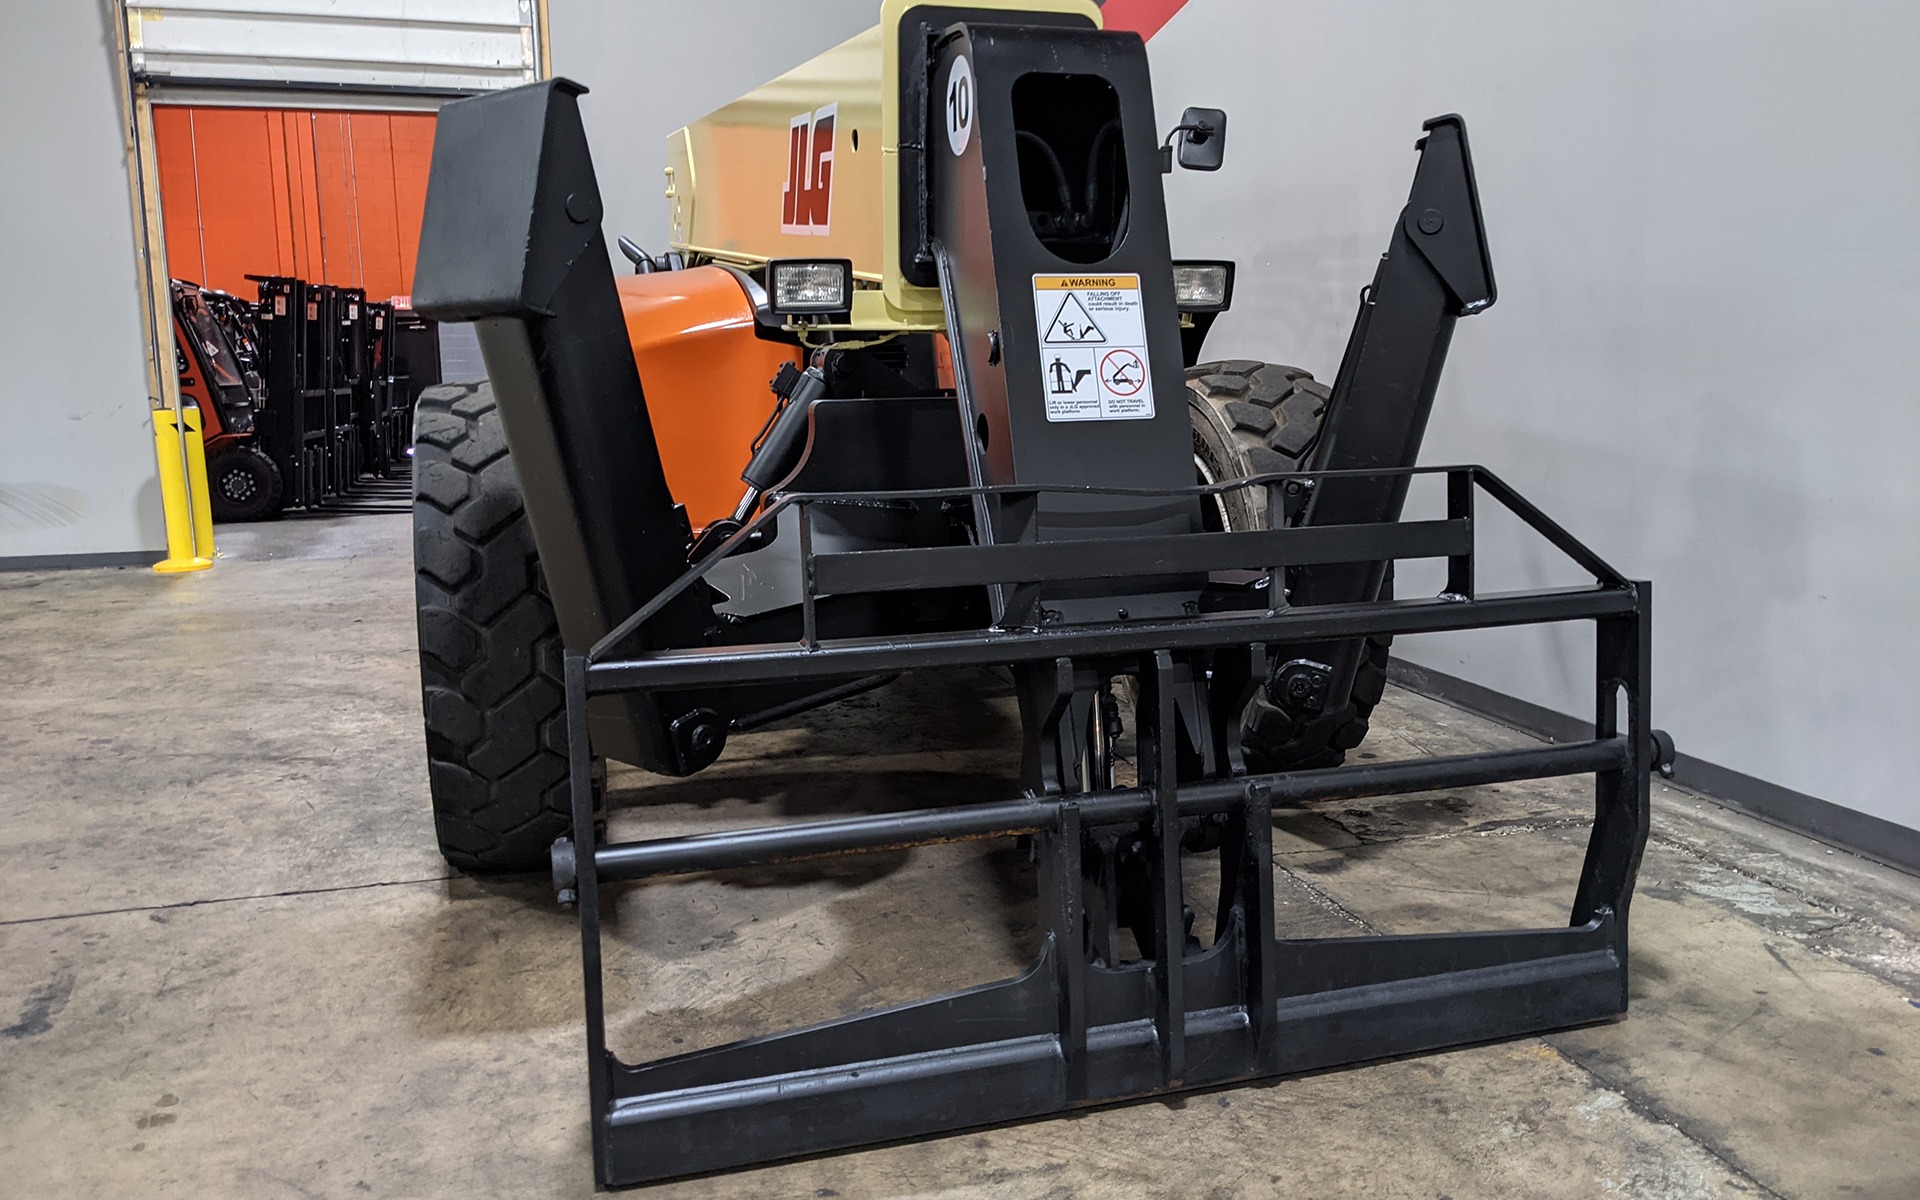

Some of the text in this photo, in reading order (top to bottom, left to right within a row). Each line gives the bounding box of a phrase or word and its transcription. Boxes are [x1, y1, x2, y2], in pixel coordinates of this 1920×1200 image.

[949, 75, 969, 133] 10
[783, 114, 834, 226] JLG
[1069, 278, 1116, 287] WARNING
